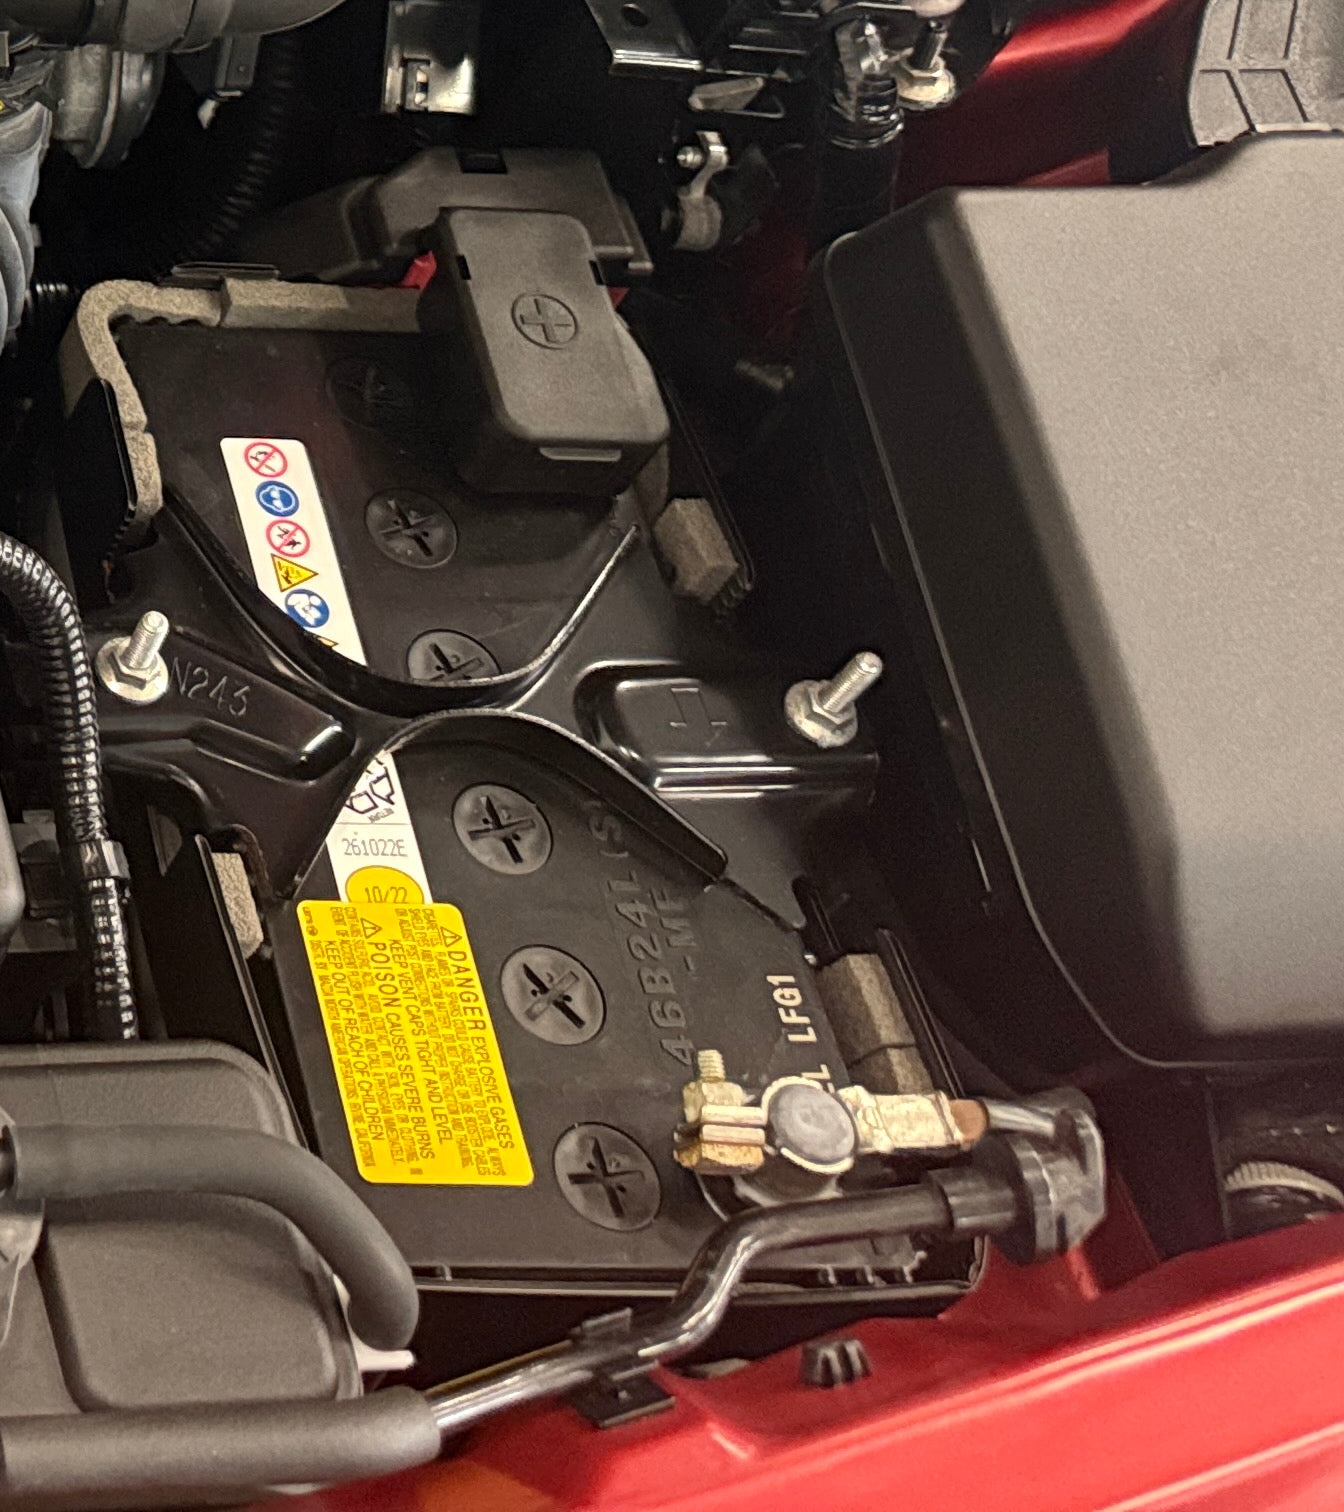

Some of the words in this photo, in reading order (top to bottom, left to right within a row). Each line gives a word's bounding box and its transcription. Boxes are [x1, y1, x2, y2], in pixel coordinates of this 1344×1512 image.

[341, 838, 408, 858] 261022E
[364, 885, 408, 904] 10/22
[322, 939, 344, 969] KEEP
[387, 938, 409, 970] KEEP
[330, 971, 351, 995] OUT
[366, 941, 402, 1008] POISON
[395, 971, 417, 1002] VENT
[336, 997, 355, 1015] OF
[403, 1003, 426, 1037] CAPS
[766, 975, 817, 1043] LFG1
[341, 1016, 366, 1058] REACH
[384, 1012, 411, 1061] CAUSES
[445, 950, 487, 1031] DANGER
[469, 1036, 502, 1103] EXPLOSIVE
[488, 1106, 515, 1149] GASES
[351, 1060, 371, 1078] OF
[412, 1038, 436, 1075] TIGHT
[396, 1063, 424, 1114] SEVERE
[421, 1077, 443, 1104] AND
[356, 1079, 386, 1141] CHILDREN
[429, 1106, 454, 1145] LEVEL
[409, 1115, 437, 1160] BURNS
